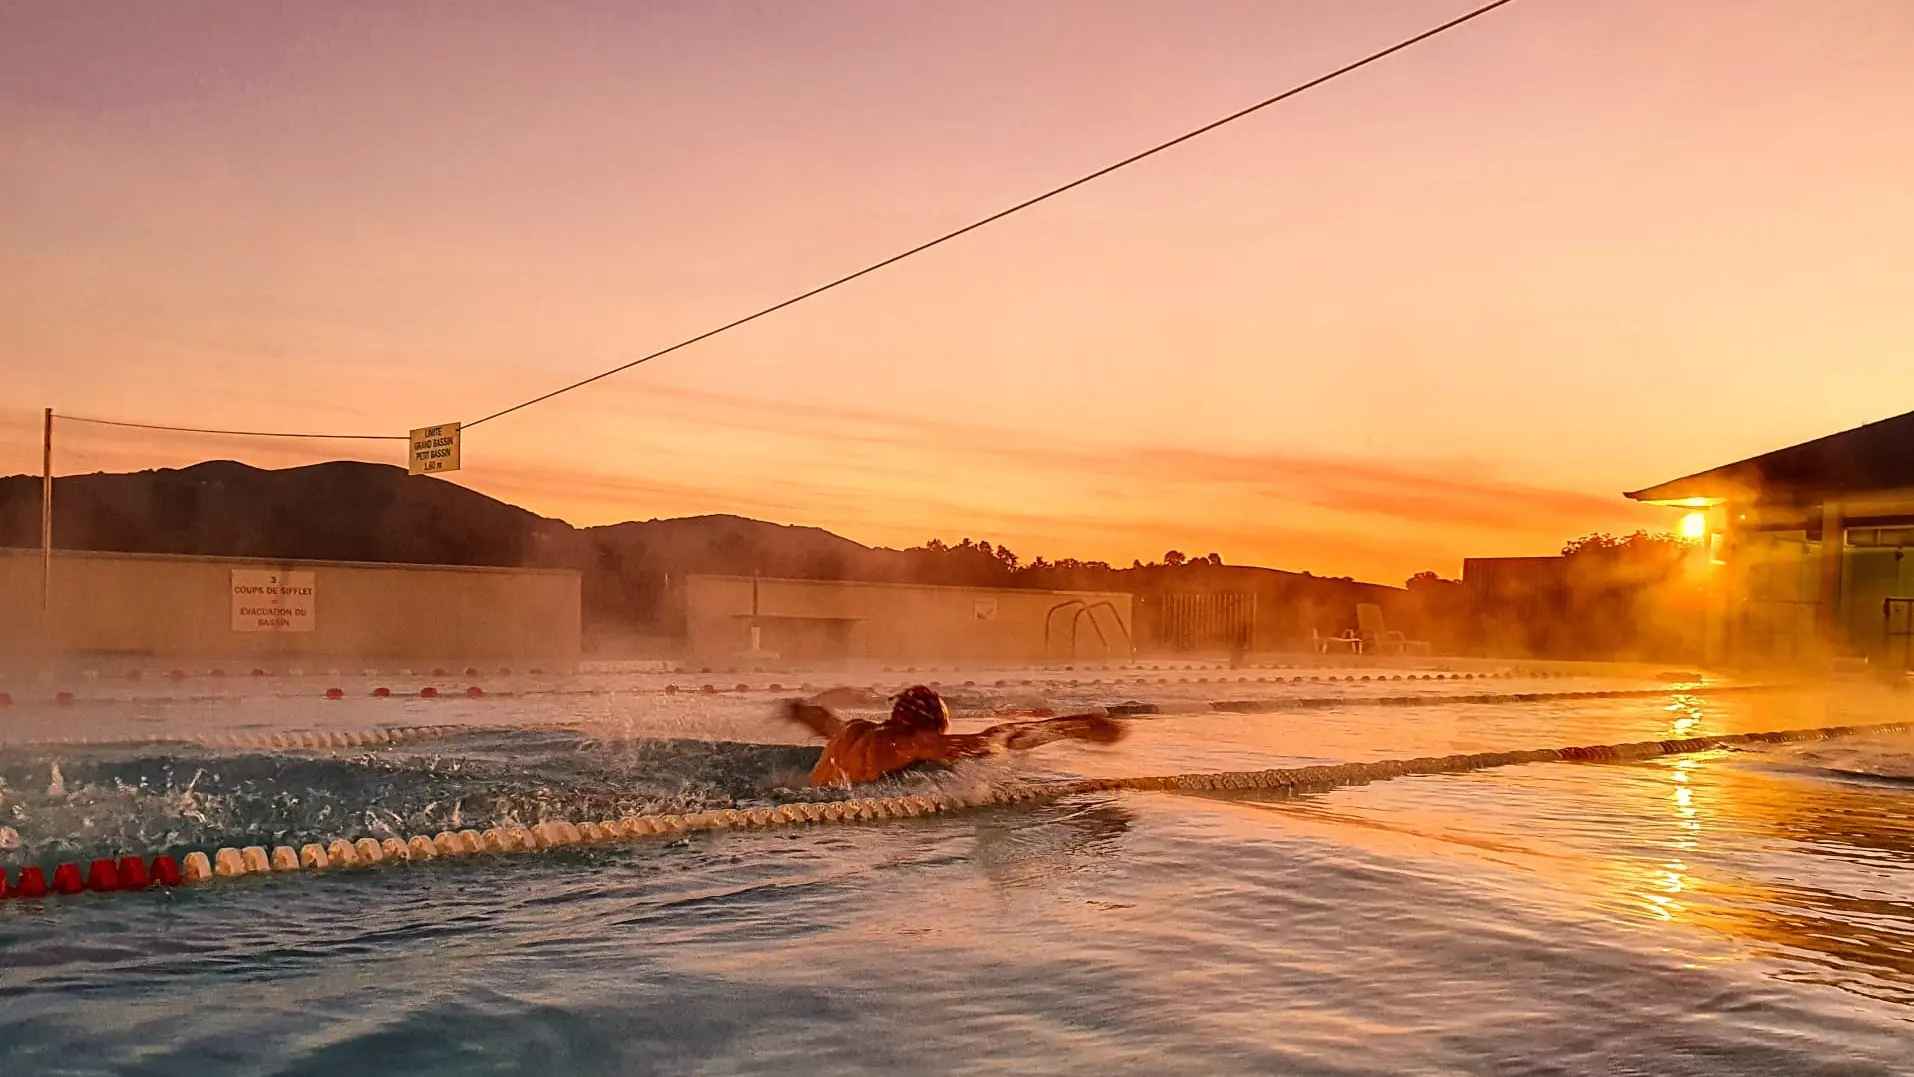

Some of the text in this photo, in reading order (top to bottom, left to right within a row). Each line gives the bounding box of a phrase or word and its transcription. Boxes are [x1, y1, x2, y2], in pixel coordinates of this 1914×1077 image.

[415, 437, 453, 450] GRAND BASSIN
[416, 448, 450, 460] PETIT BASSIN
[266, 587, 278, 595] DE
[281, 587, 312, 595] SIFFLET
[240, 607, 306, 616] EVACUATION DU
